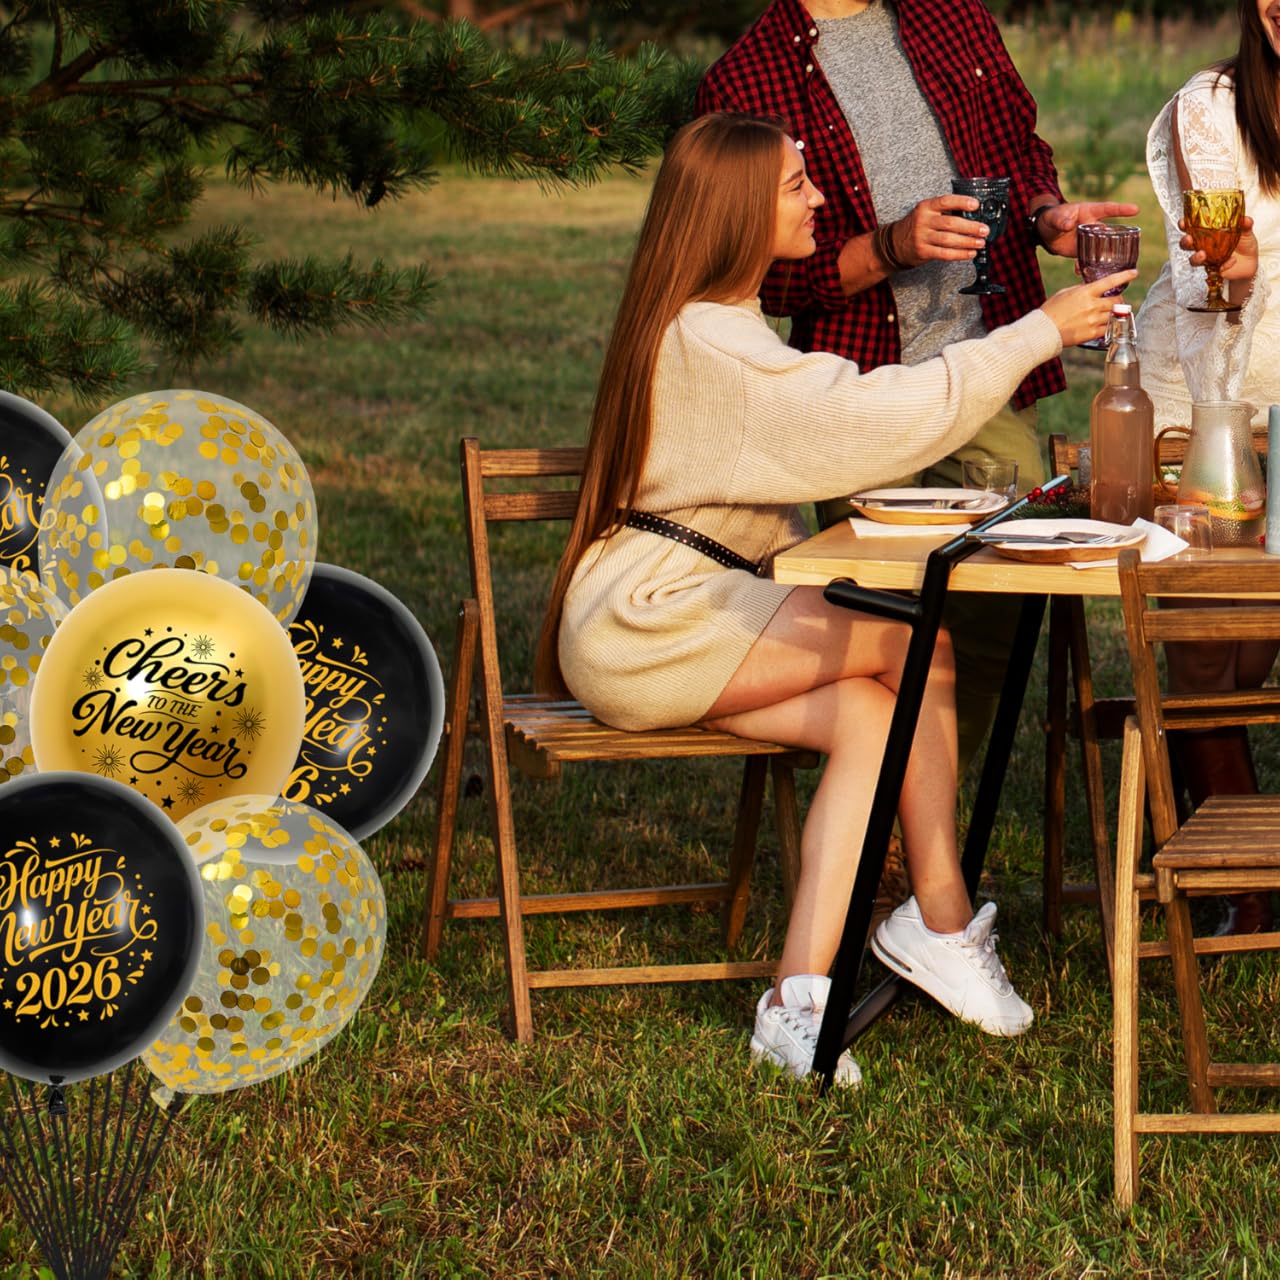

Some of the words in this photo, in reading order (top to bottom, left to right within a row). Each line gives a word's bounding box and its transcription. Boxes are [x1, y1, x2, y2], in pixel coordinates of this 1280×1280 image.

[103, 637, 248, 707] Cheers
[147, 694, 168, 710] TO
[171, 699, 203, 718] THE
[292, 632, 372, 724] appy
[72, 689, 163, 737] New
[130, 721, 248, 780] Year
[55, 889, 158, 963] Year
[15, 956, 122, 1016] 2026
